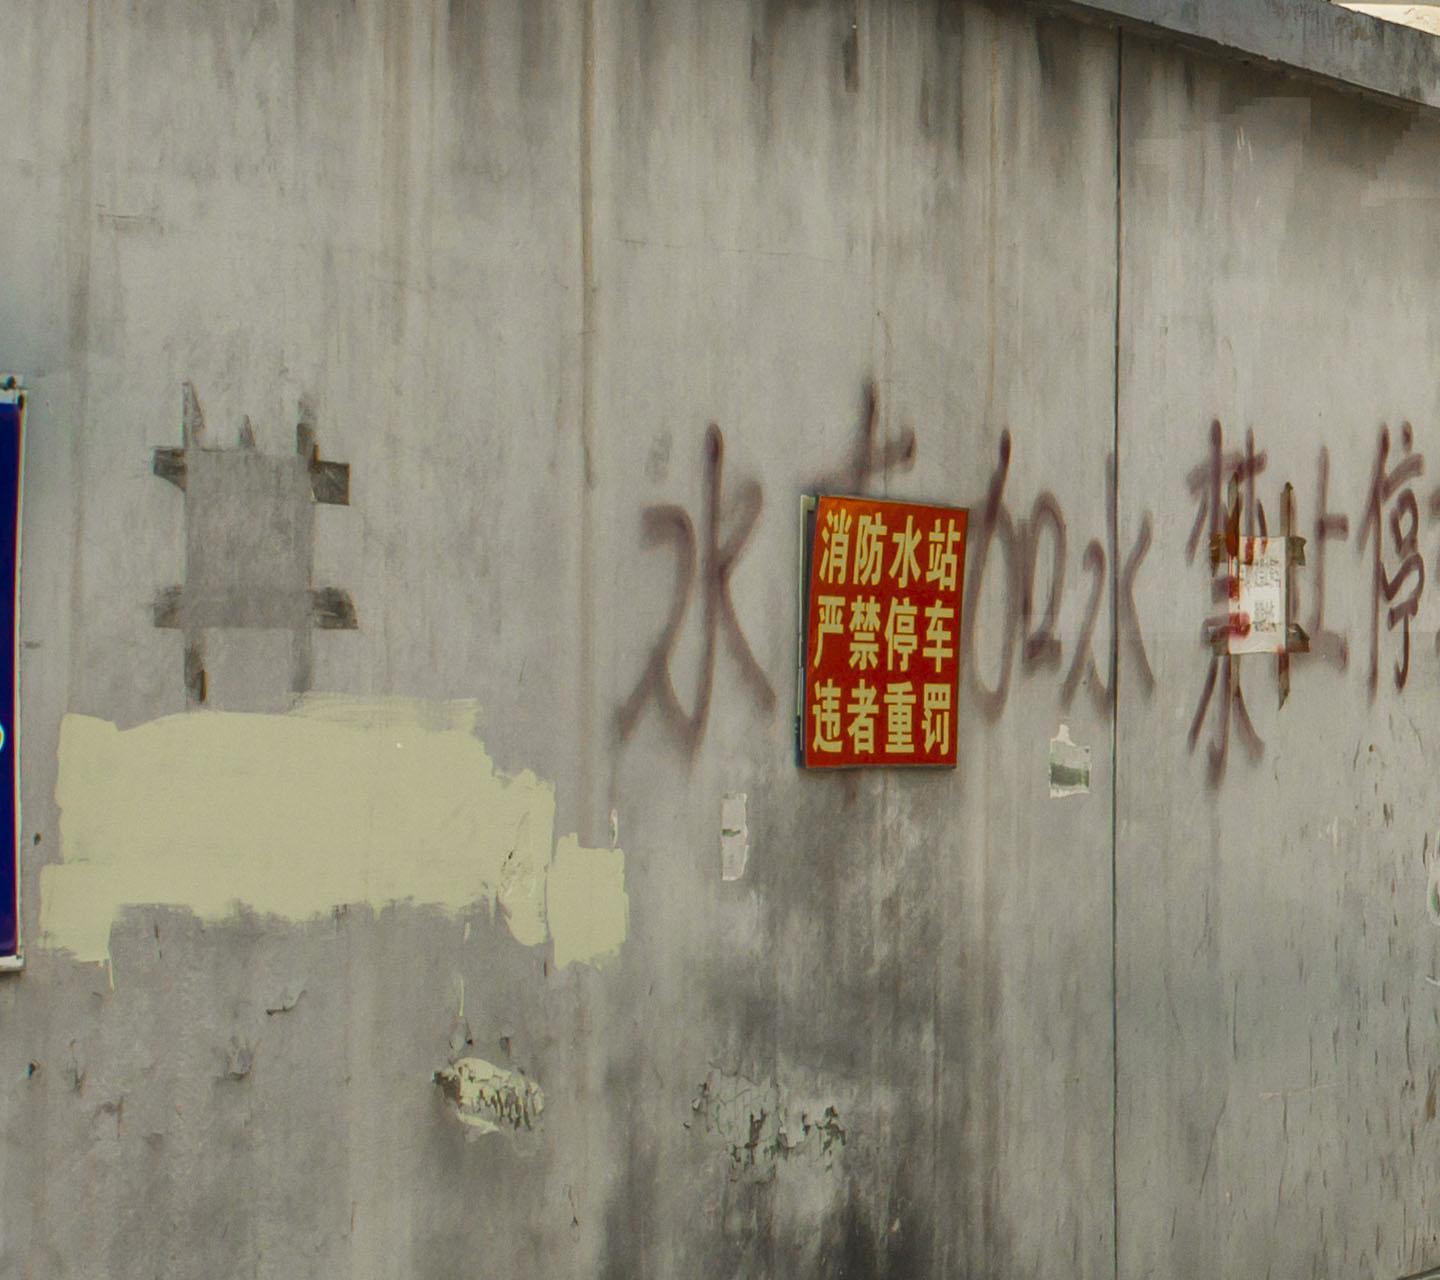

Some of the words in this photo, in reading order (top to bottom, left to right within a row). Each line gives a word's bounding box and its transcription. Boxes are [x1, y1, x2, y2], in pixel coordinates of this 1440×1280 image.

[819, 508, 961, 591] 消防水站
[813, 595, 954, 672] 严禁停车
[812, 678, 951, 755] 违者重罚
